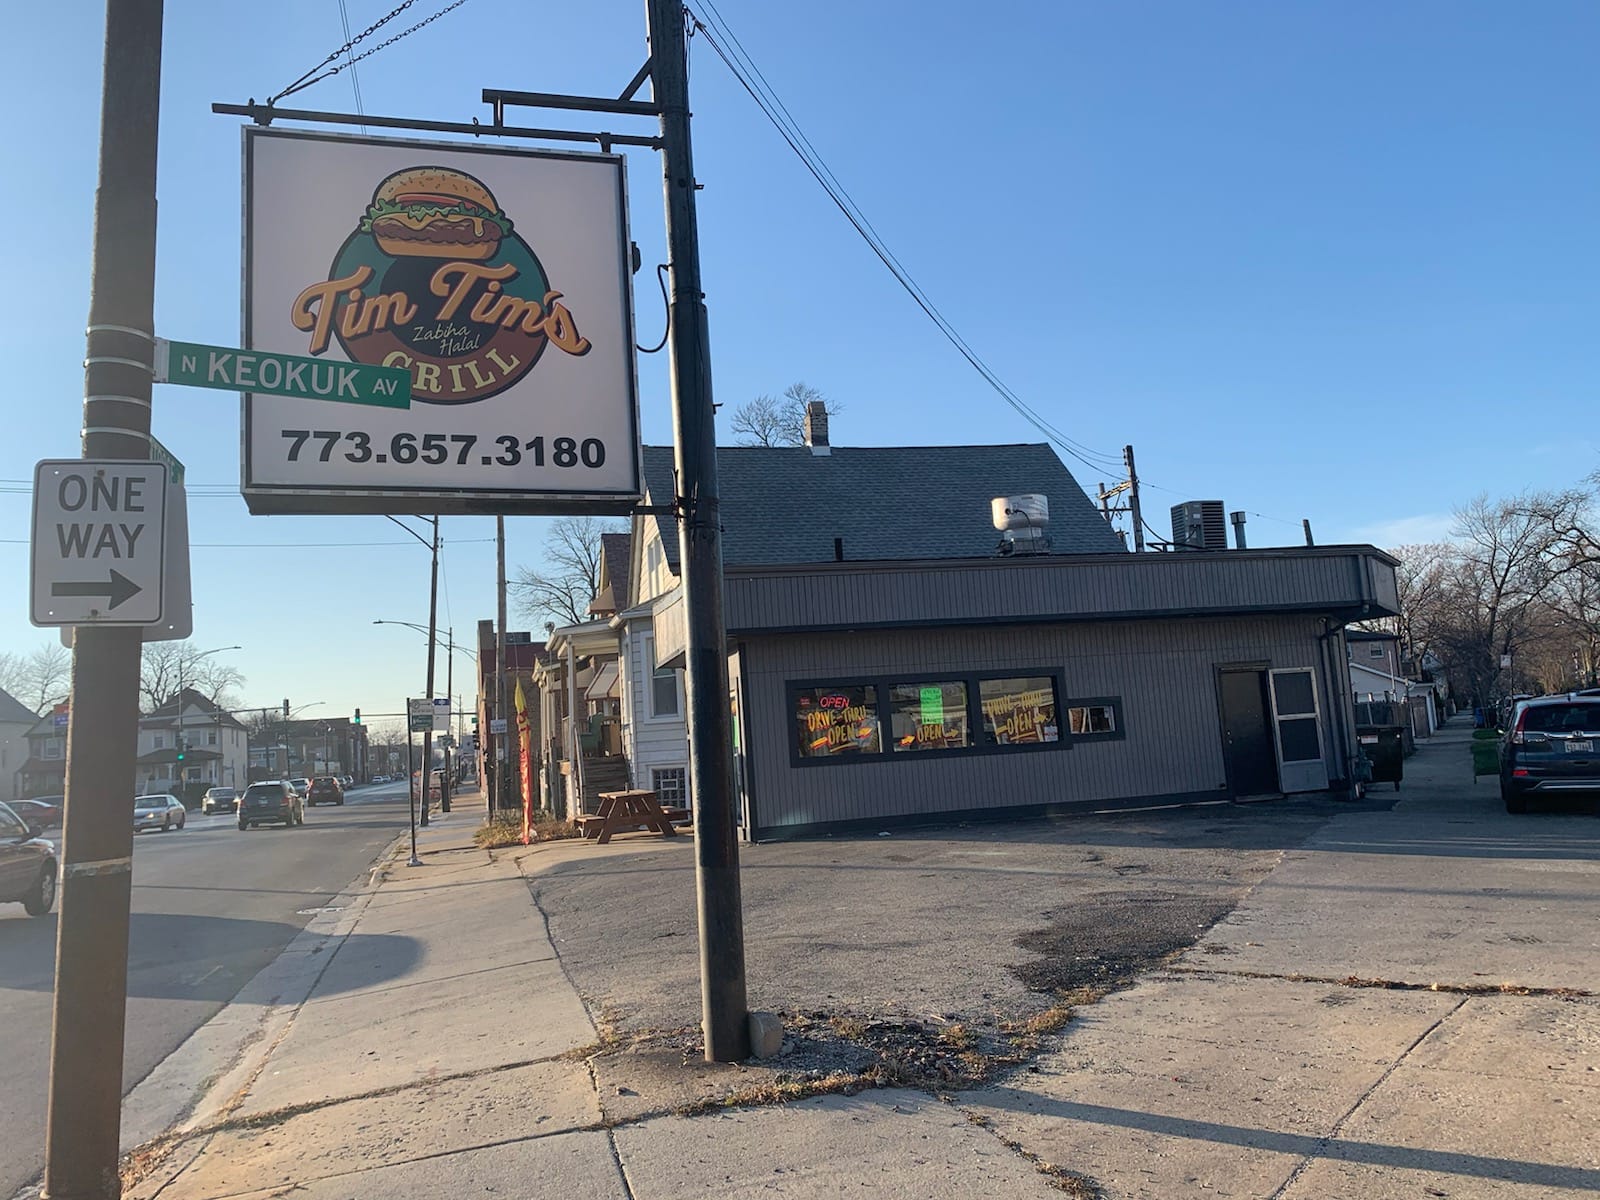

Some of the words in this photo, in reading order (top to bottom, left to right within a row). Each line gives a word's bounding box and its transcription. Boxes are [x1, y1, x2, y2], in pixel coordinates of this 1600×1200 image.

[291, 265, 419, 354] Tim
[430, 261, 592, 356] Tim's
[412, 319, 471, 342] Zabiha
[439, 334, 481, 355] Halal
[182, 356, 196, 374] N
[207, 351, 361, 398] KEOKUK
[372, 378, 399, 396] AV
[281, 430, 606, 468] 773.657.3180
[58, 474, 146, 513] ONE
[56, 523, 145, 559] WAY
[820, 696, 850, 708] OPEN
[828, 723, 856, 745] OPEN
[917, 723, 943, 742] OPEN
[1007, 711, 1032, 735] OPEN
